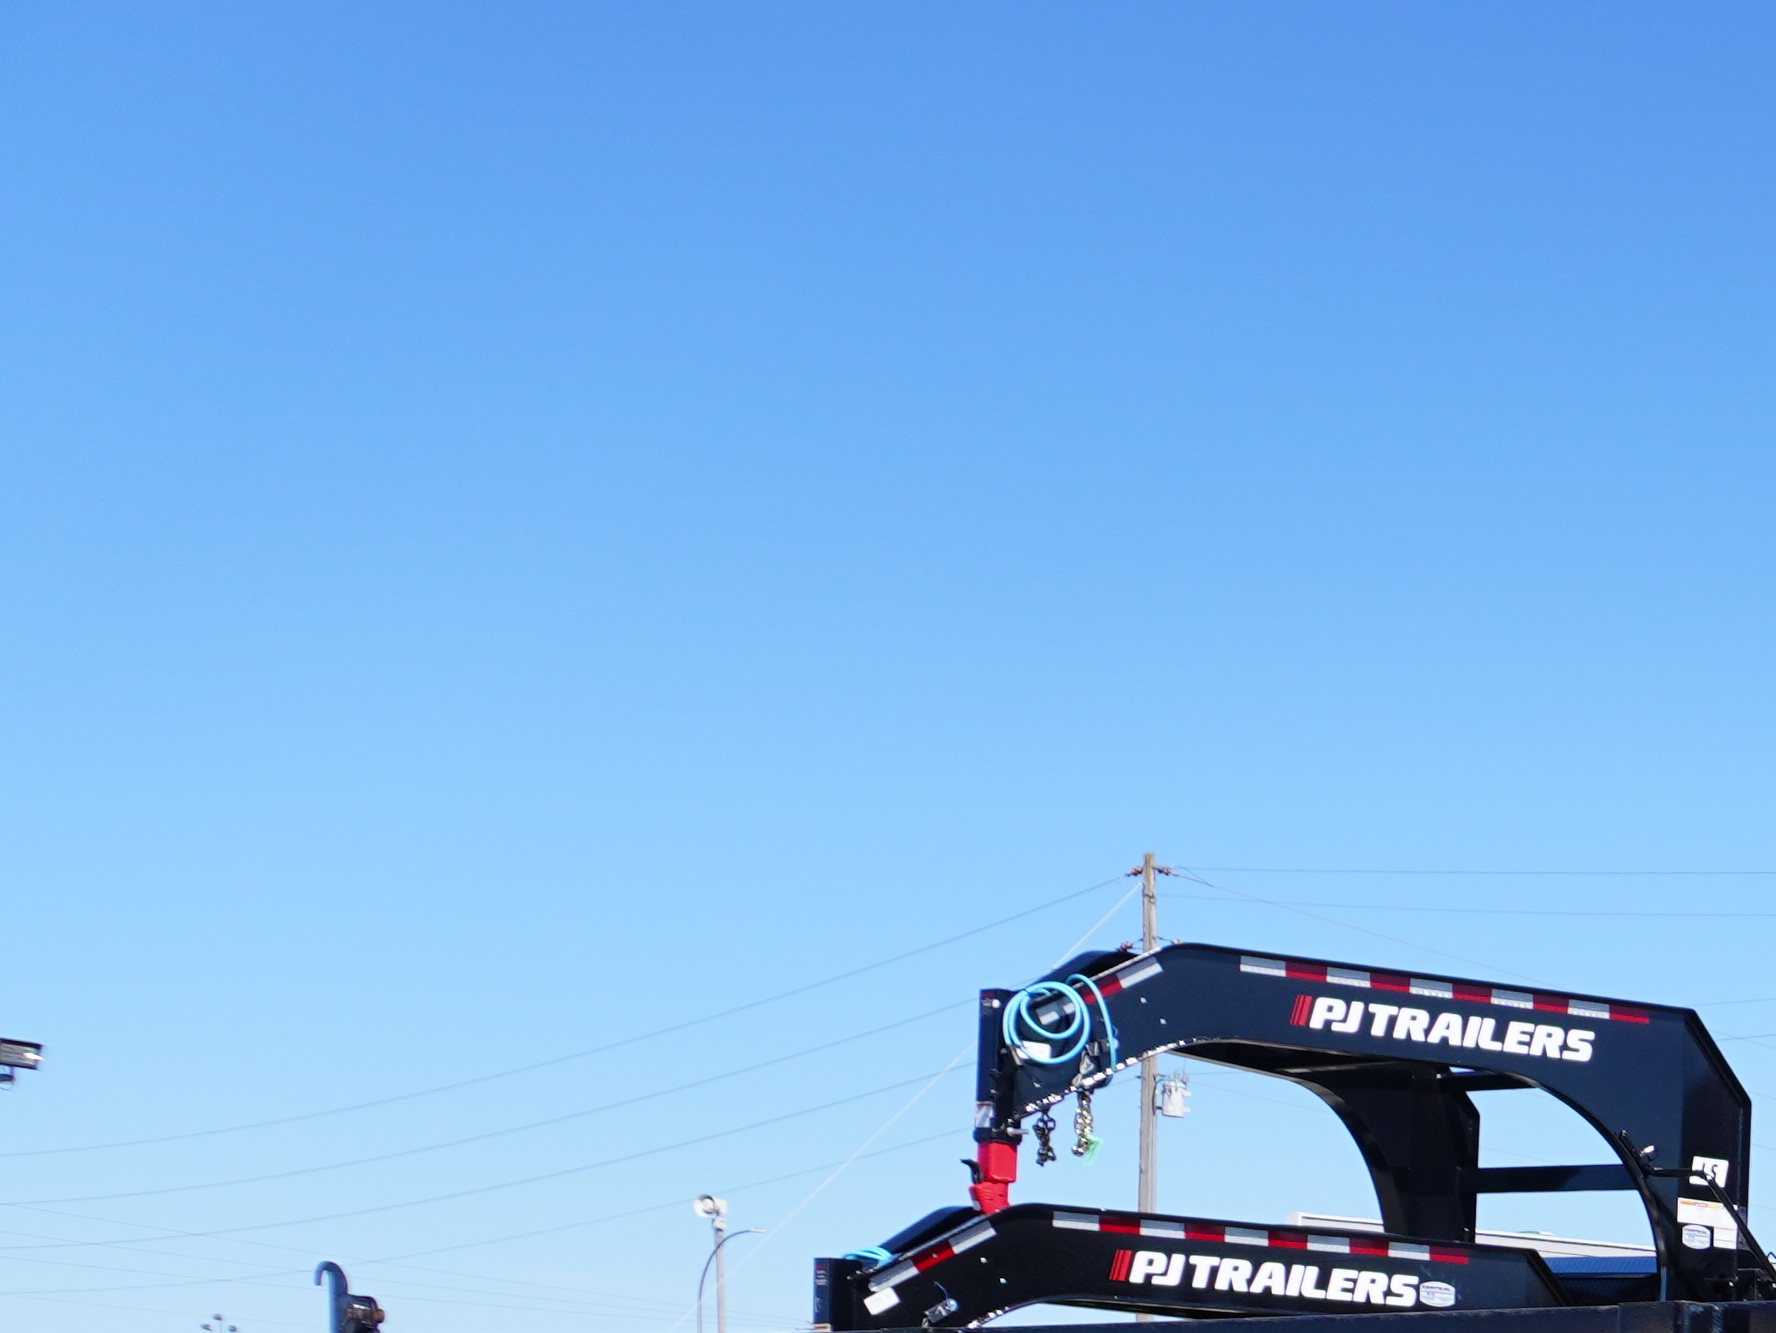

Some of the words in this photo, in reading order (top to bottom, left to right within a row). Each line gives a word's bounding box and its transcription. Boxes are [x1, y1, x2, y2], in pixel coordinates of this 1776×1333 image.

[1308, 996, 1365, 1034] PJ
[1368, 1002, 1596, 1062] TRAILERS
[1129, 1250, 1187, 1287] PJ
[1189, 1254, 1420, 1307] TRAILERS
